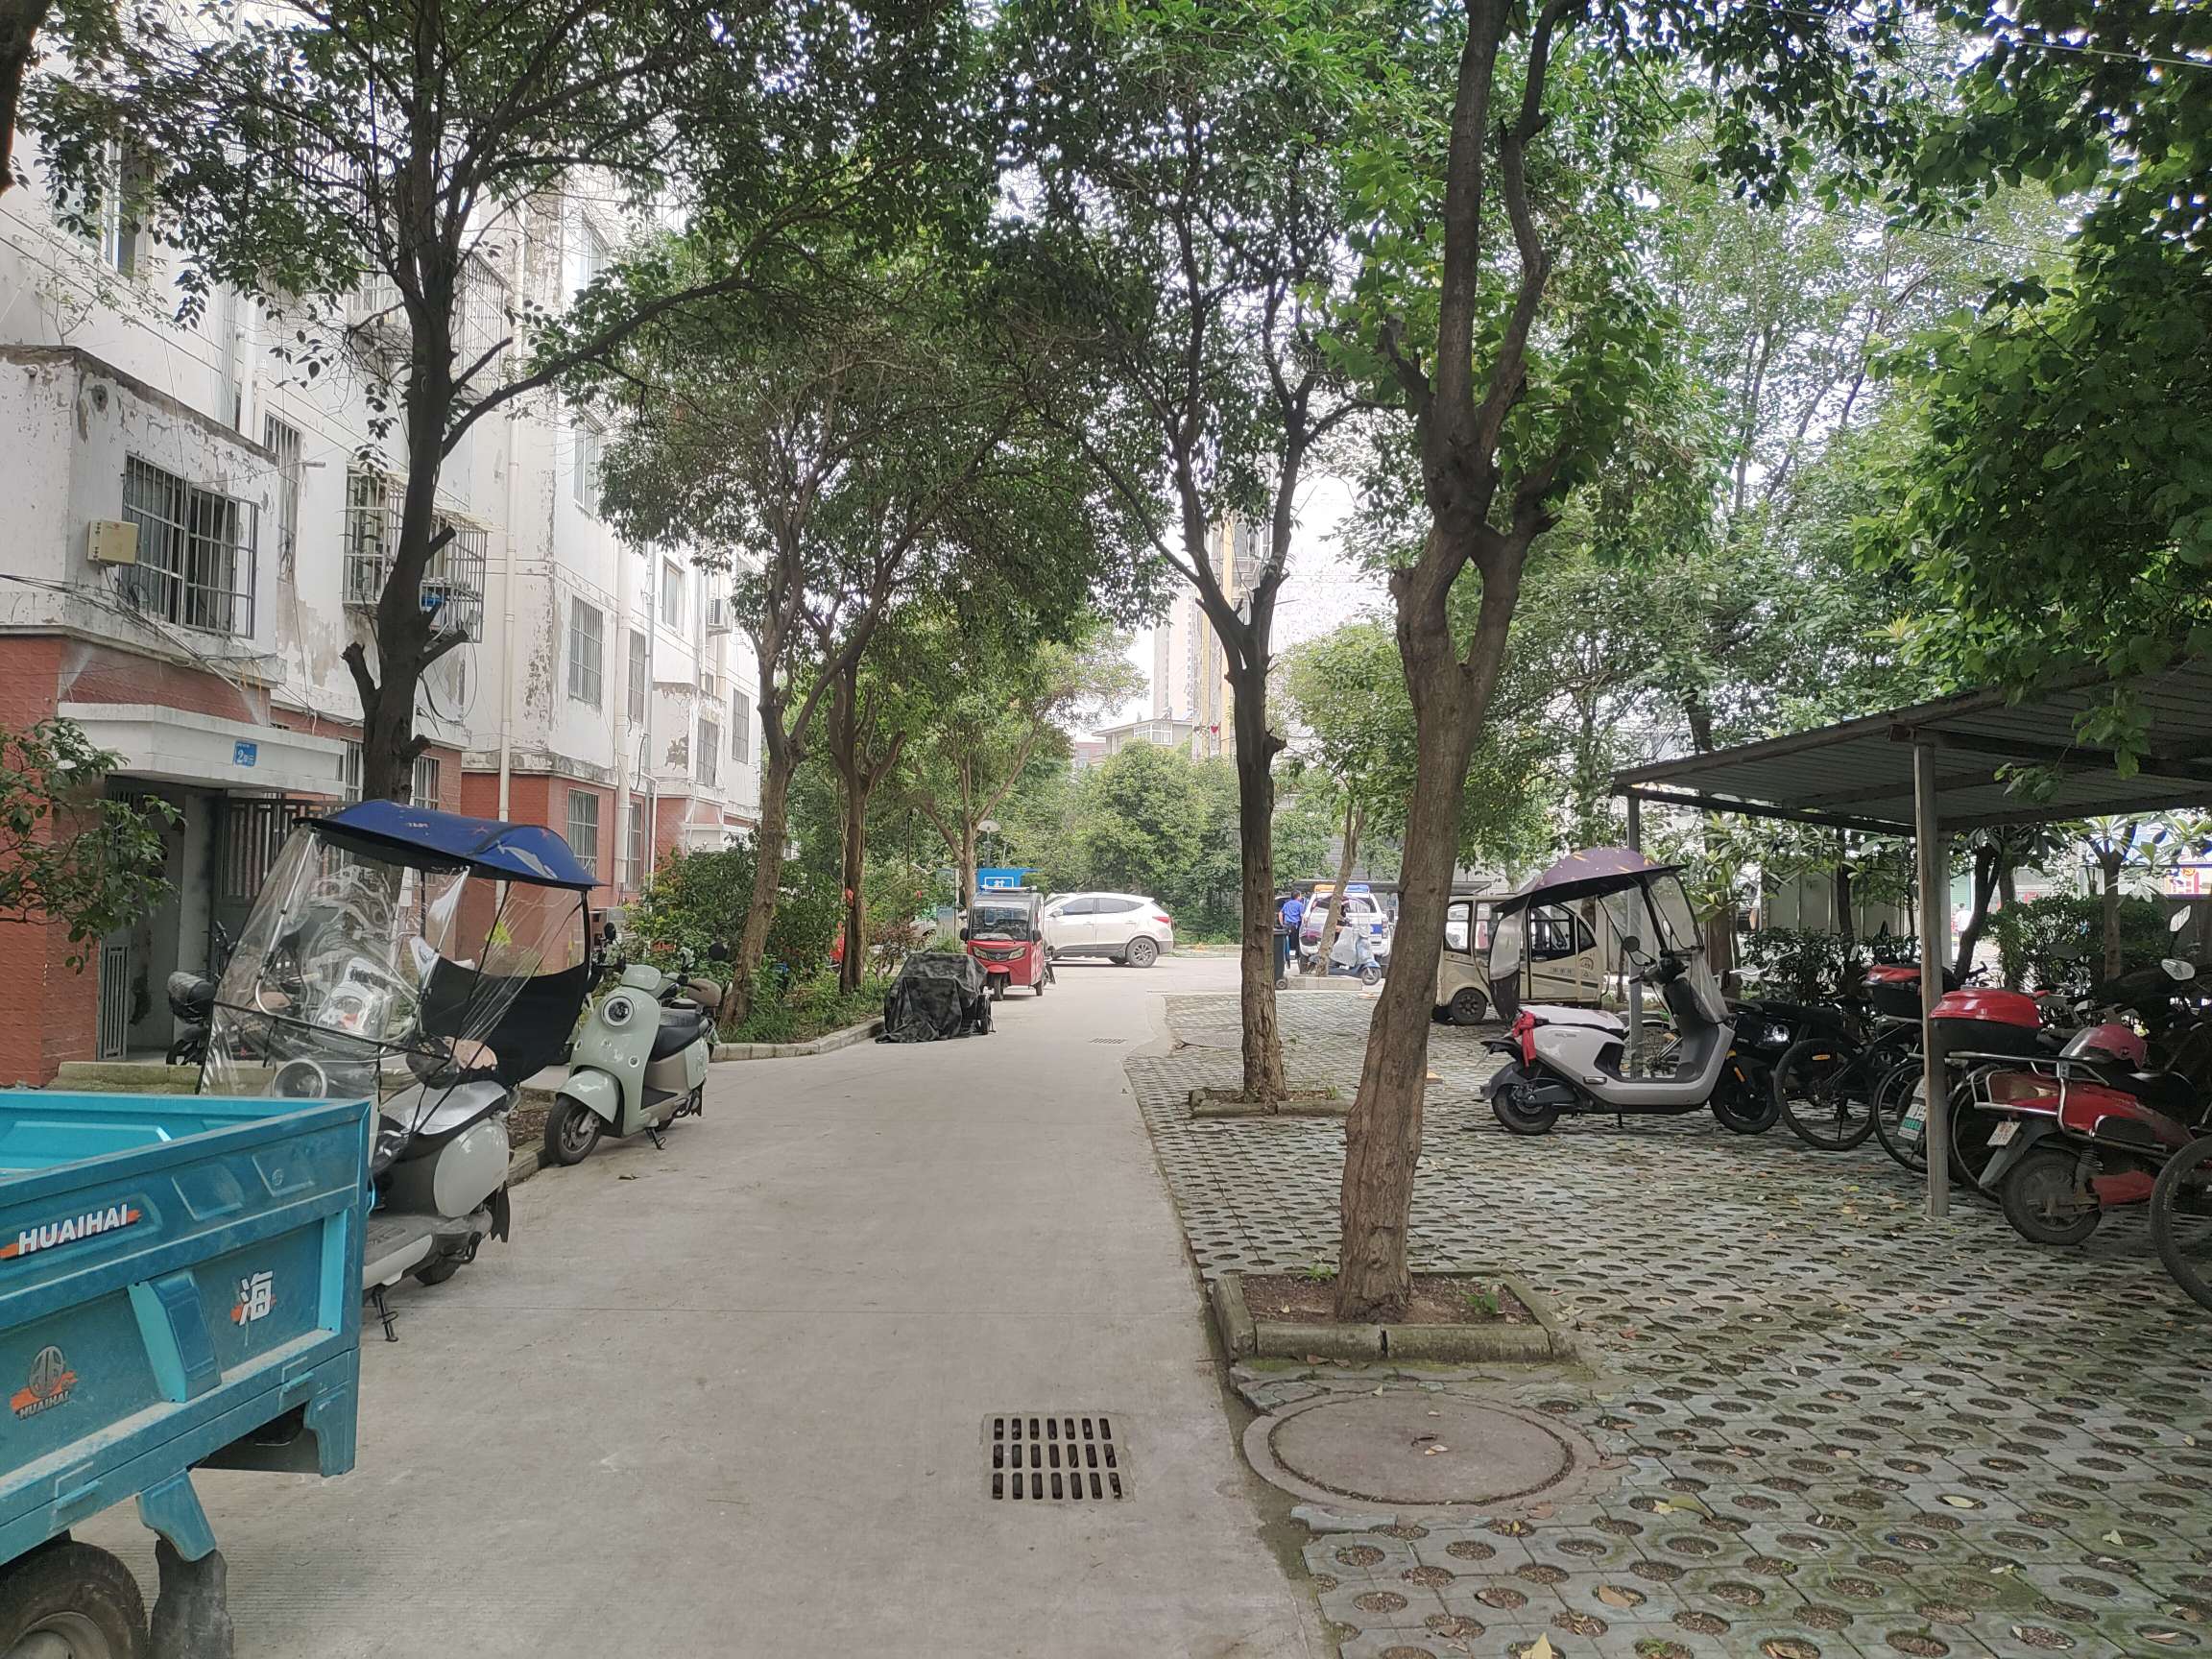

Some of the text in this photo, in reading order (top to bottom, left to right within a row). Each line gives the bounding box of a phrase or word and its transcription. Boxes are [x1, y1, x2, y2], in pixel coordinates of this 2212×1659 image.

[18, 1204, 128, 1255] HUAIHAI
[239, 1270, 273, 1326] 海
[19, 1390, 69, 1420] HUAIHAI
